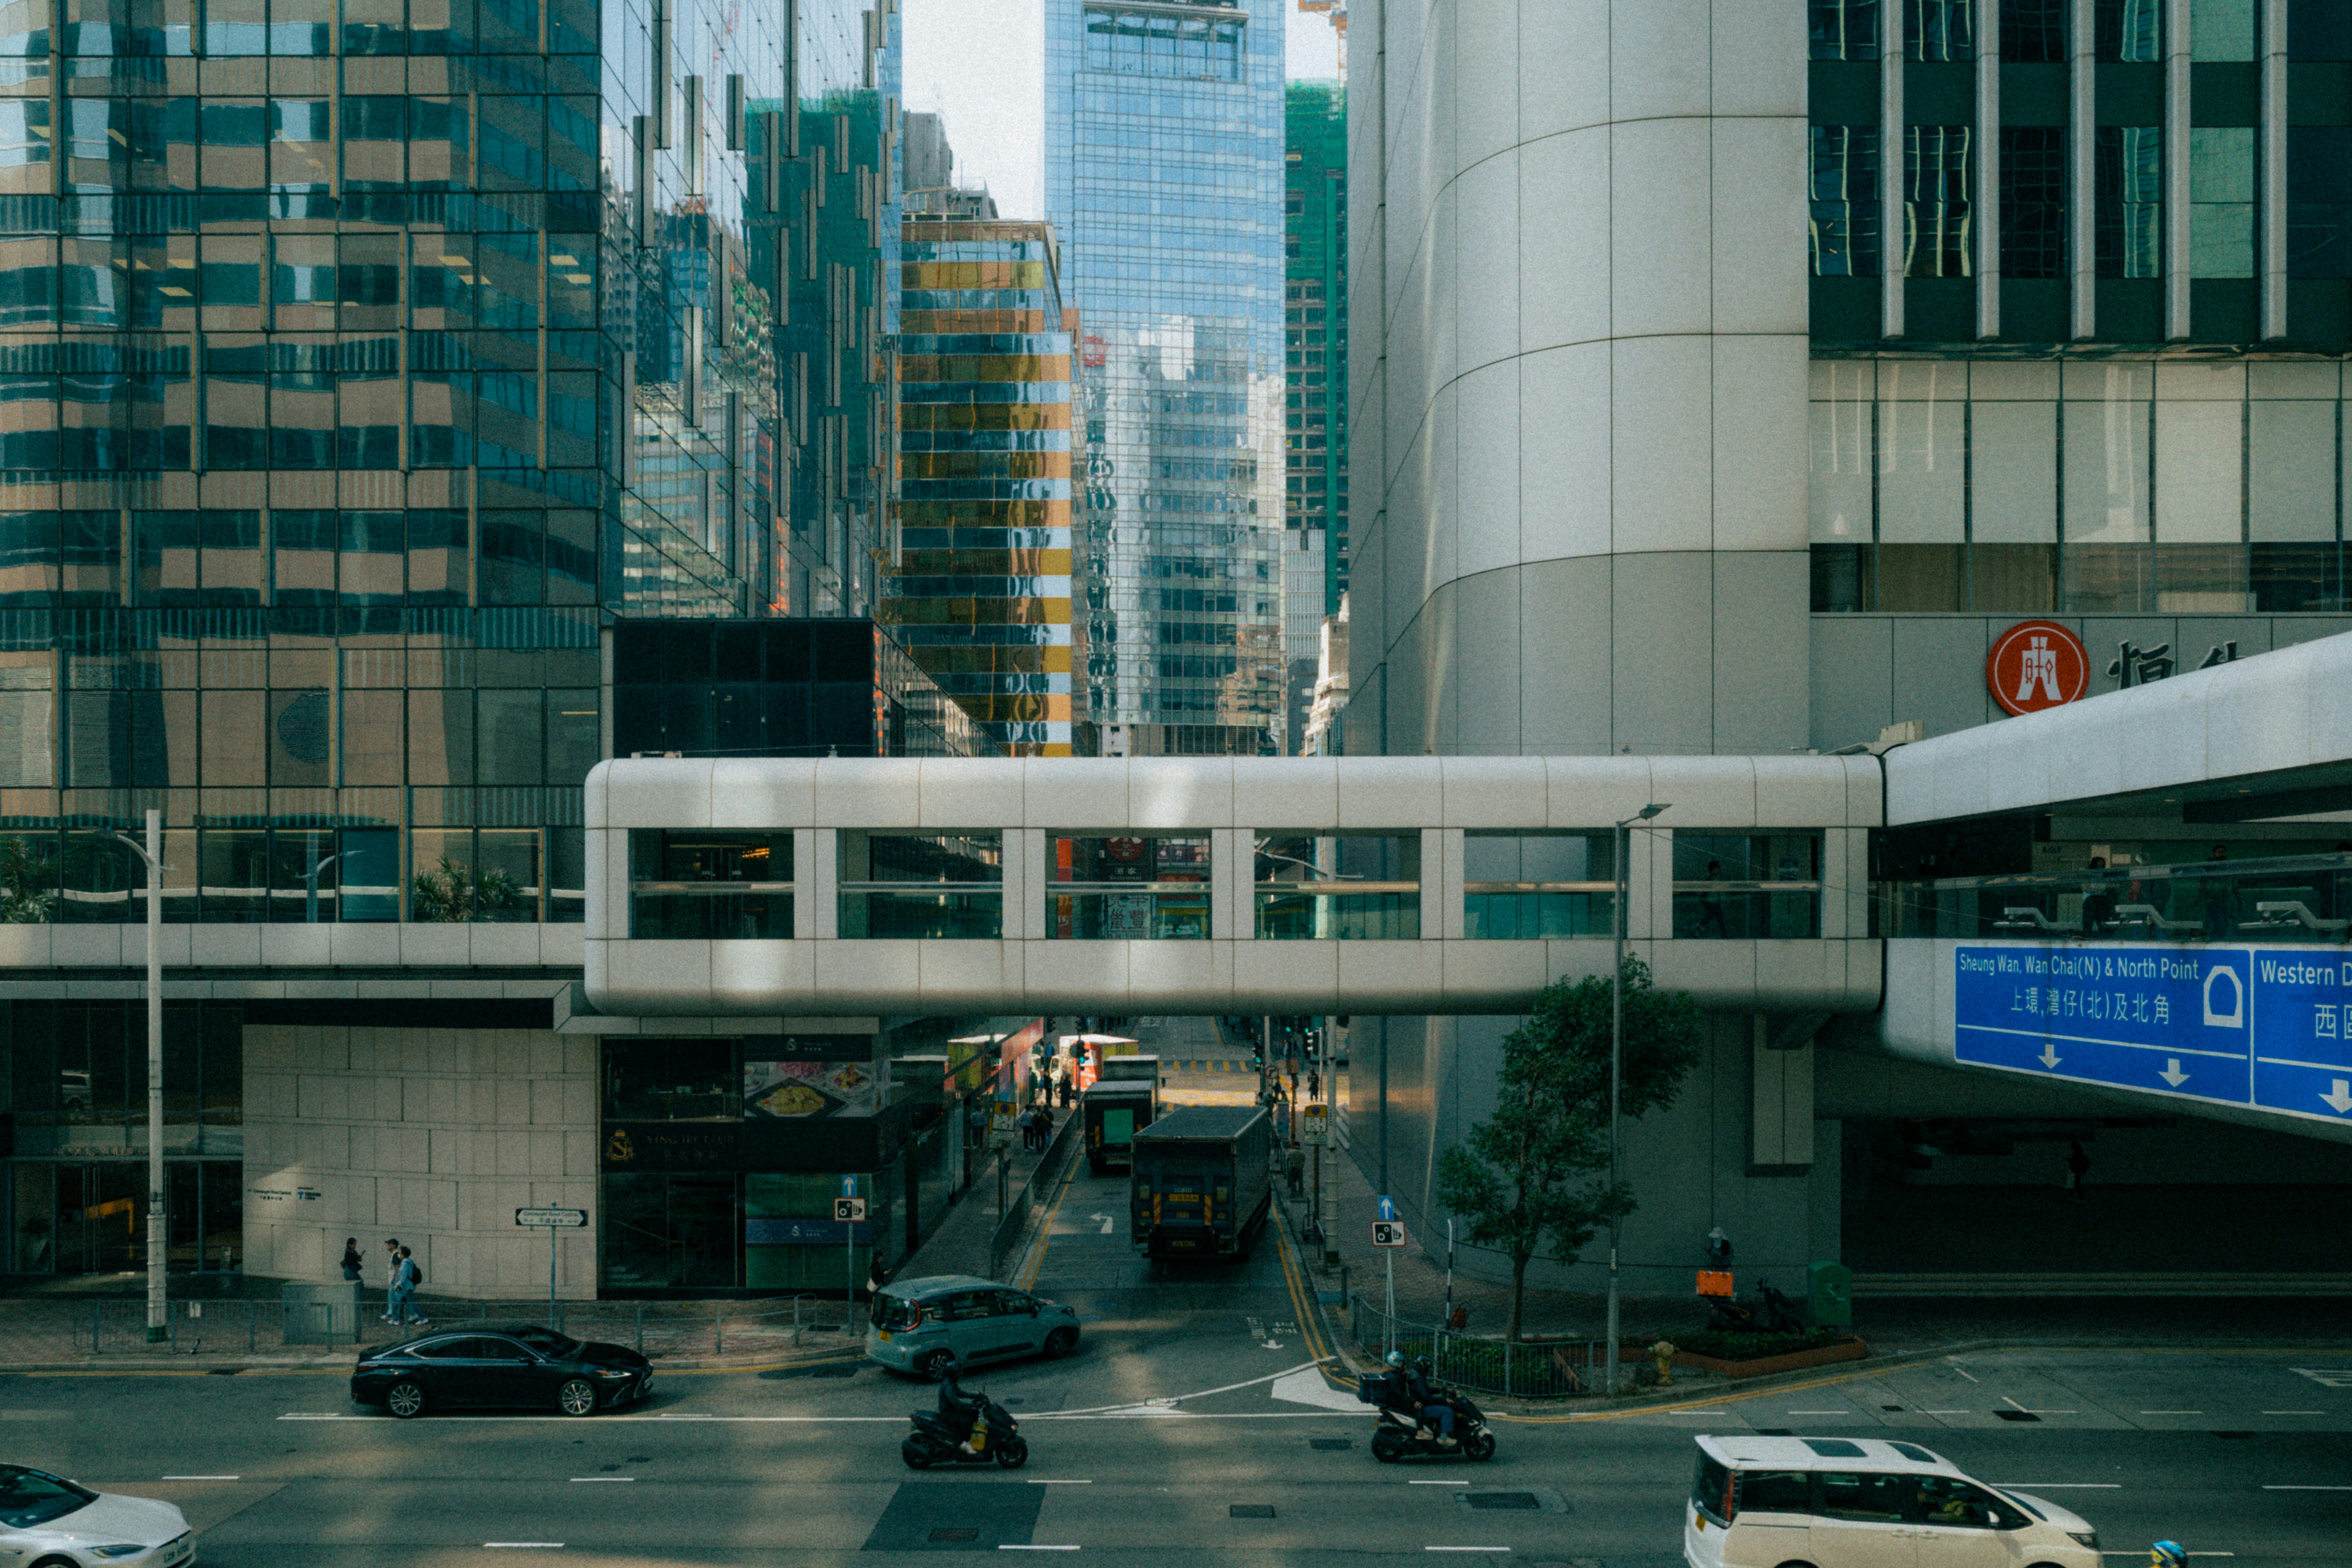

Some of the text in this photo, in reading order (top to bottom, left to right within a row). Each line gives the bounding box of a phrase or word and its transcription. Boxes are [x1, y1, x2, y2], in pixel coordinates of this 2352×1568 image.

[1960, 954, 2199, 980] Sheung Wan, Wan Chai(N) & North Point
[2260, 960, 2334, 985] Western
